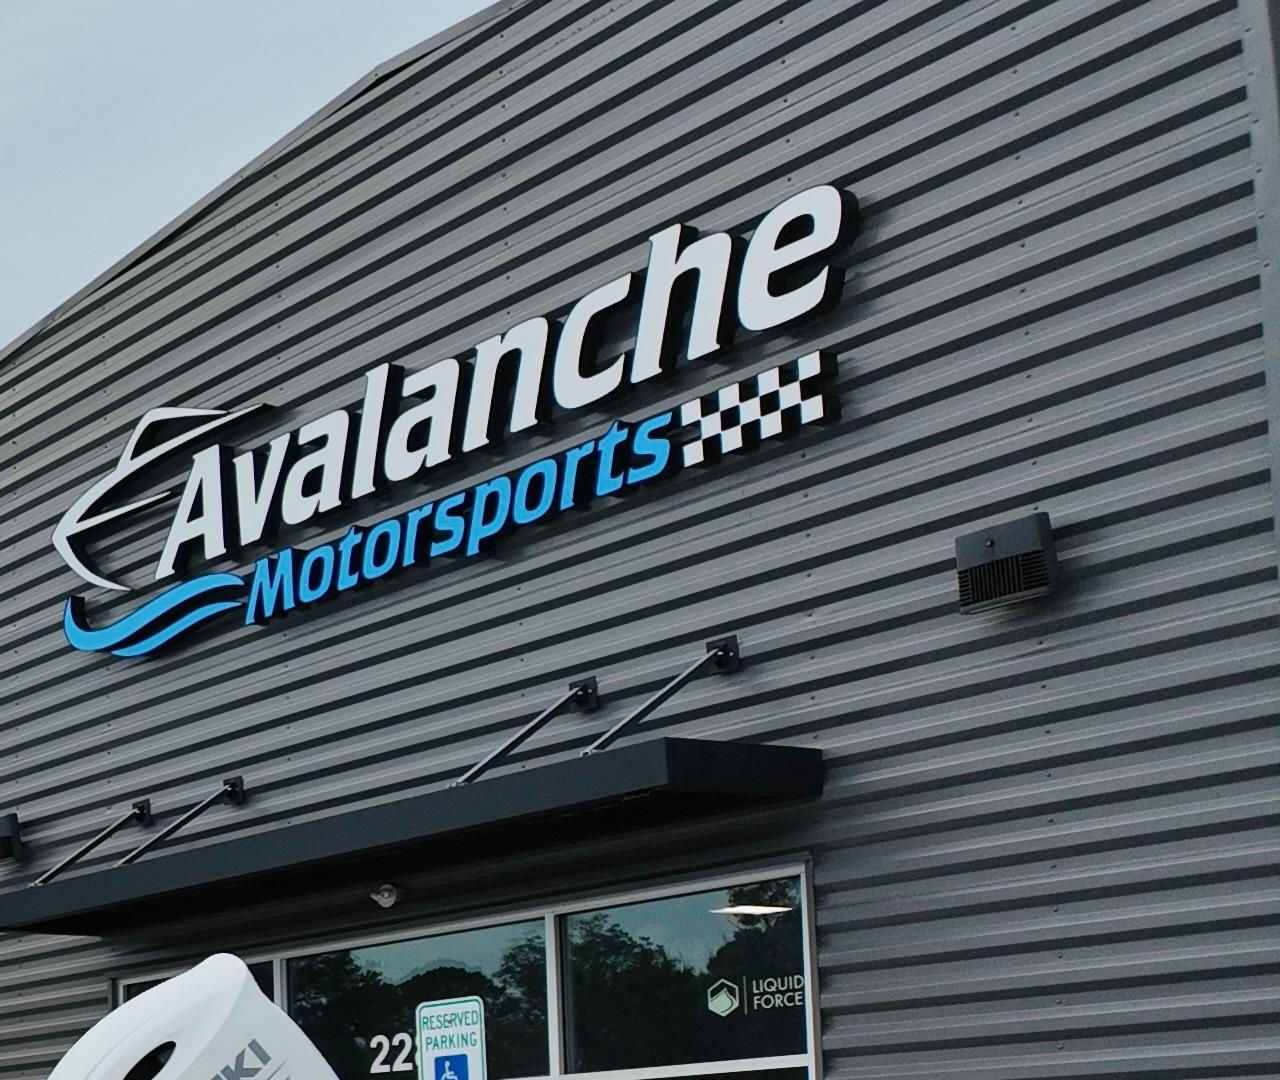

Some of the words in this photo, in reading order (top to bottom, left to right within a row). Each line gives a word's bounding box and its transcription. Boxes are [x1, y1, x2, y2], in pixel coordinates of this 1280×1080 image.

[154, 184, 842, 580] Avalanche
[244, 408, 673, 626] Motorsports
[752, 975, 805, 994] LIQUID
[753, 991, 804, 1010] FORCE
[422, 1010, 479, 1031] RESERVED
[425, 1031, 478, 1051] PARKING
[369, 1032, 419, 1074] 22
